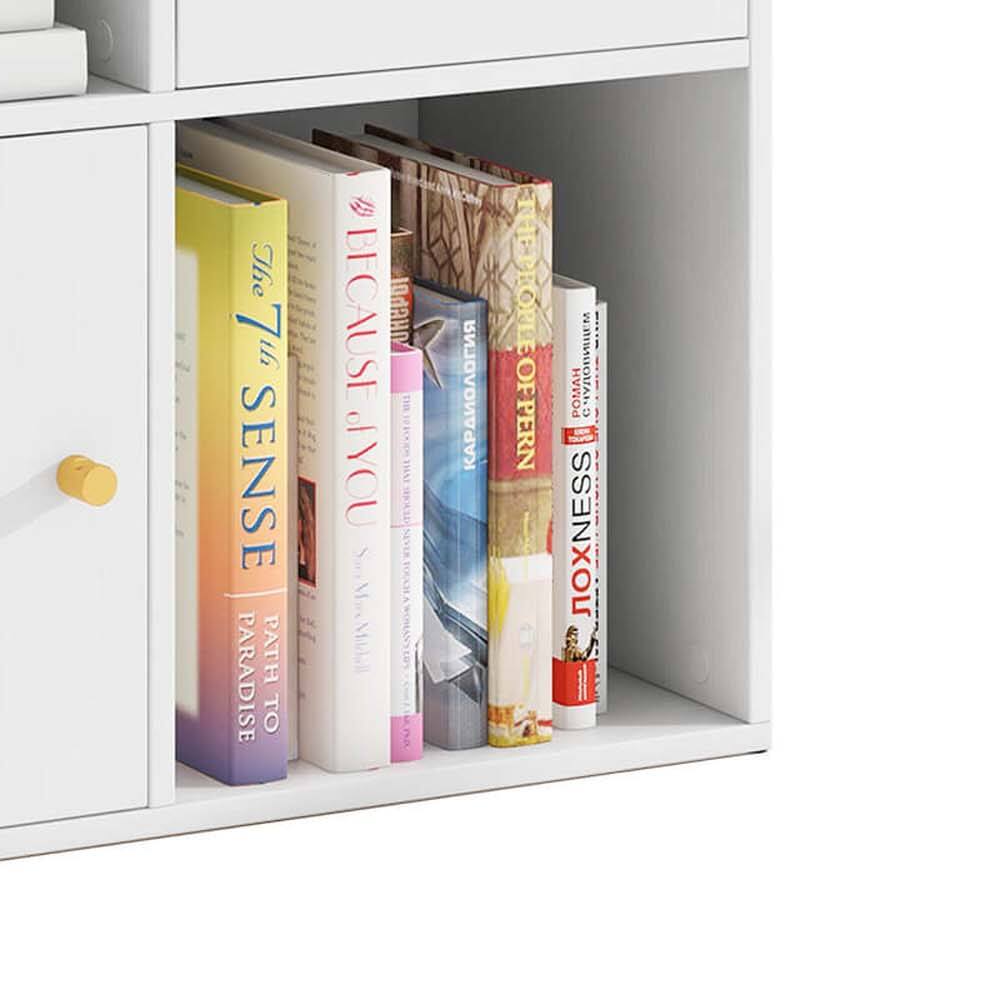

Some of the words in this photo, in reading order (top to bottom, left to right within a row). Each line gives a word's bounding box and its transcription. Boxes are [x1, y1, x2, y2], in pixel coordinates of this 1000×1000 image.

[252, 243, 274, 297] The
[345, 228, 379, 399] BECAUSE
[345, 411, 379, 432] of
[463, 319, 476, 470] КАРДИОЛОГИЯ
[571, 368, 582, 419] РОМАН
[516, 396, 537, 470] PERN
[241, 385, 277, 570] SENSE
[345, 441, 379, 527] YOU
[239, 611, 257, 744] PARADISE
[263, 615, 281, 684] PATH
[263, 693, 281, 735] TO
